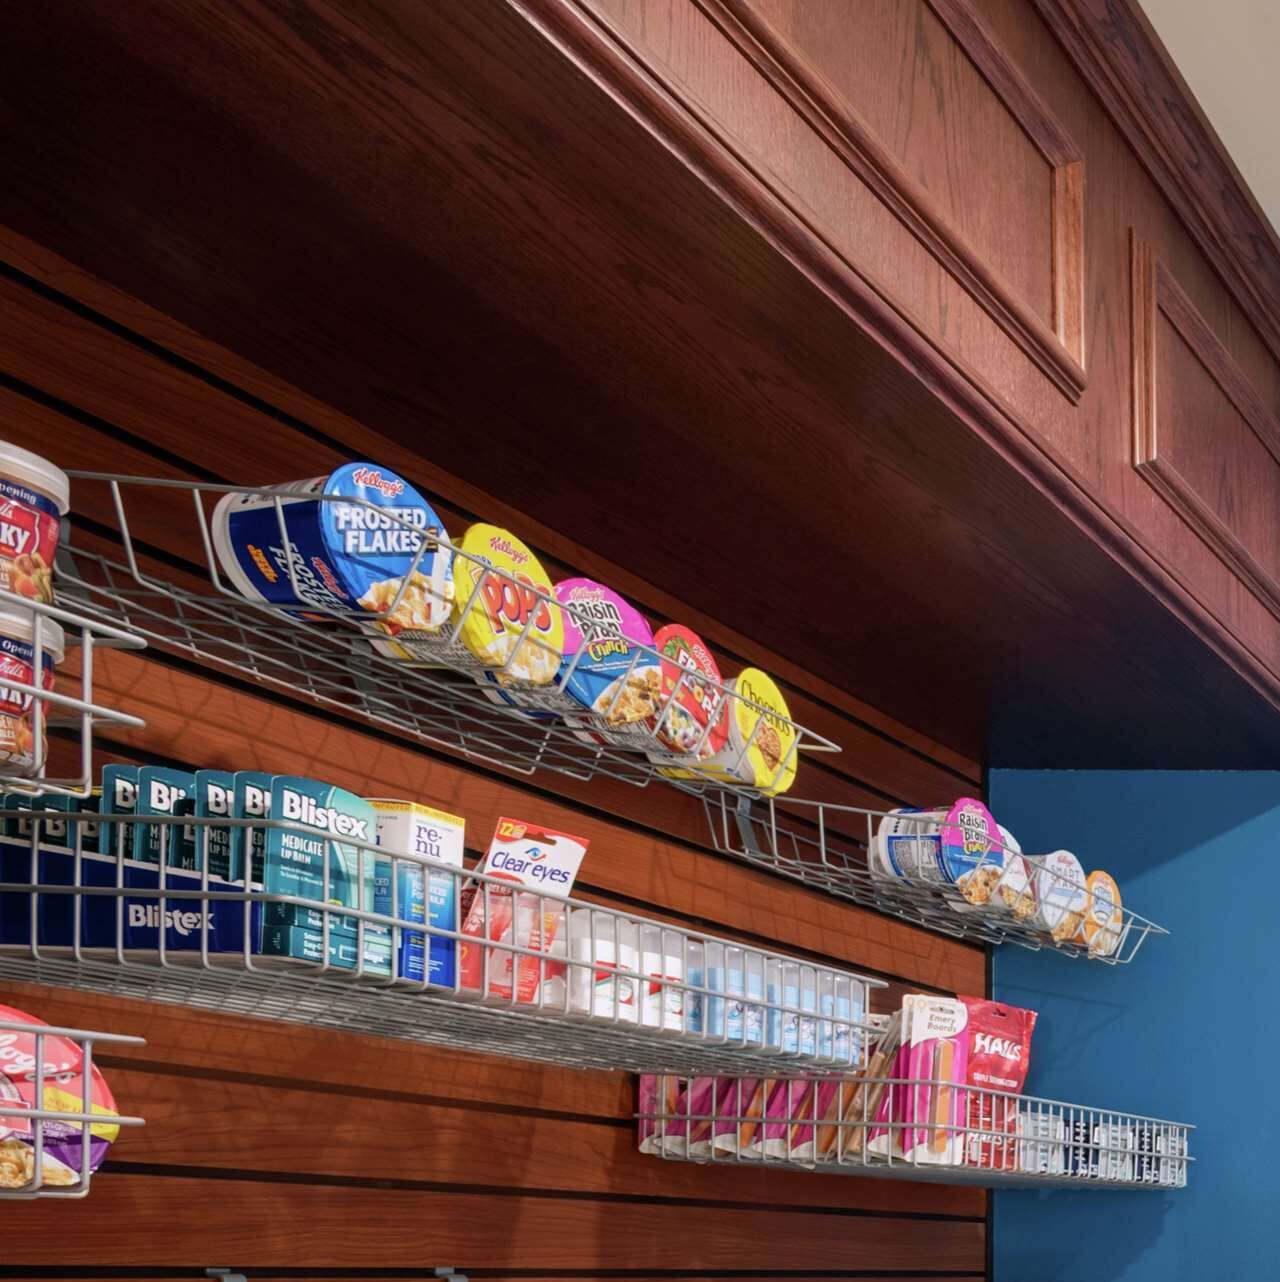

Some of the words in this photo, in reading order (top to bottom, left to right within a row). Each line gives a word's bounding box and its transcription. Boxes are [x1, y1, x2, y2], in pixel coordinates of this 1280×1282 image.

[353, 467, 403, 498] Kellogg's
[336, 507, 426, 530] FROSTED
[346, 531, 422, 553] FLAKES
[476, 570, 553, 634] POPS
[570, 600, 620, 622] Raisin
[580, 618, 620, 641] Bran
[588, 640, 628, 661] Crunch
[282, 790, 368, 840] Blistex
[959, 812, 987, 829] Raisin
[281, 833, 323, 856] MEDICATE
[492, 850, 530, 875] Clear
[532, 859, 571, 884] eyes
[128, 904, 215, 936] Blistex
[974, 1033, 1022, 1062] HALLS
